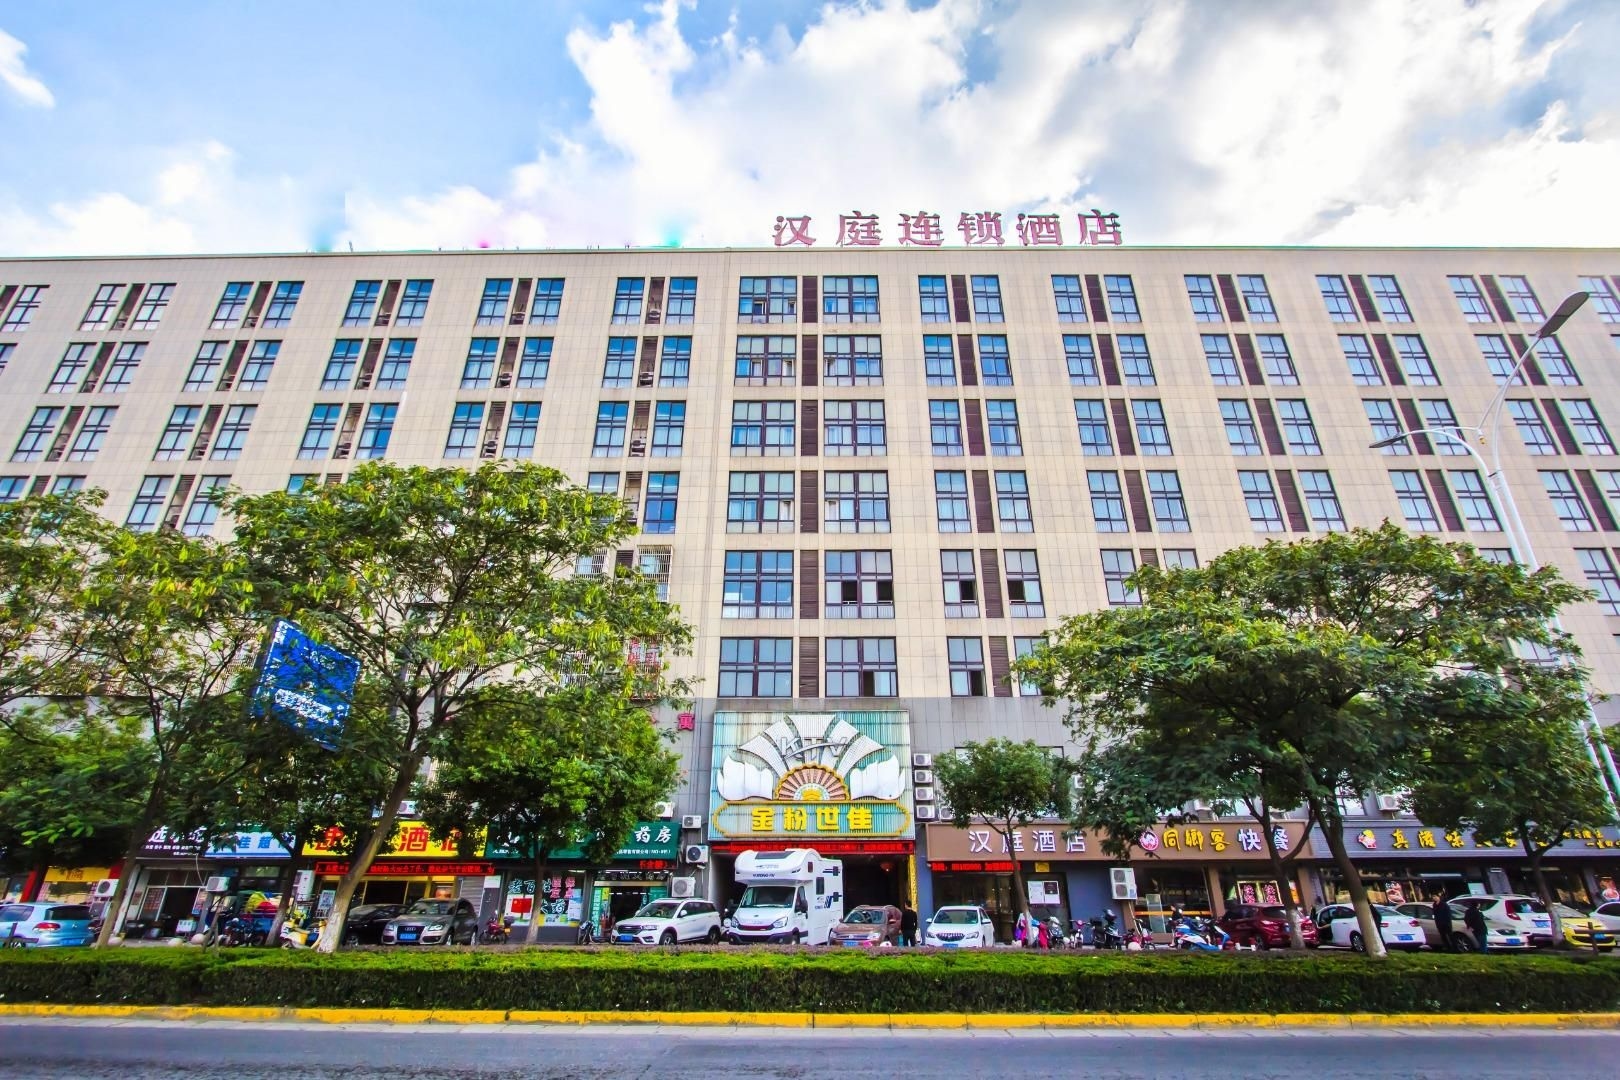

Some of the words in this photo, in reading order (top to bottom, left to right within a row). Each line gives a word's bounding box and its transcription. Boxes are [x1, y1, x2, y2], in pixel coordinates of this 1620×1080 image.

[772, 209, 1123, 247] 汉庭连锁酒店
[781, 736, 848, 760] KTV
[751, 806, 872, 831] 金粉世佳
[634, 825, 672, 843] 药房
[968, 830, 1086, 854] 汉庭酒店
